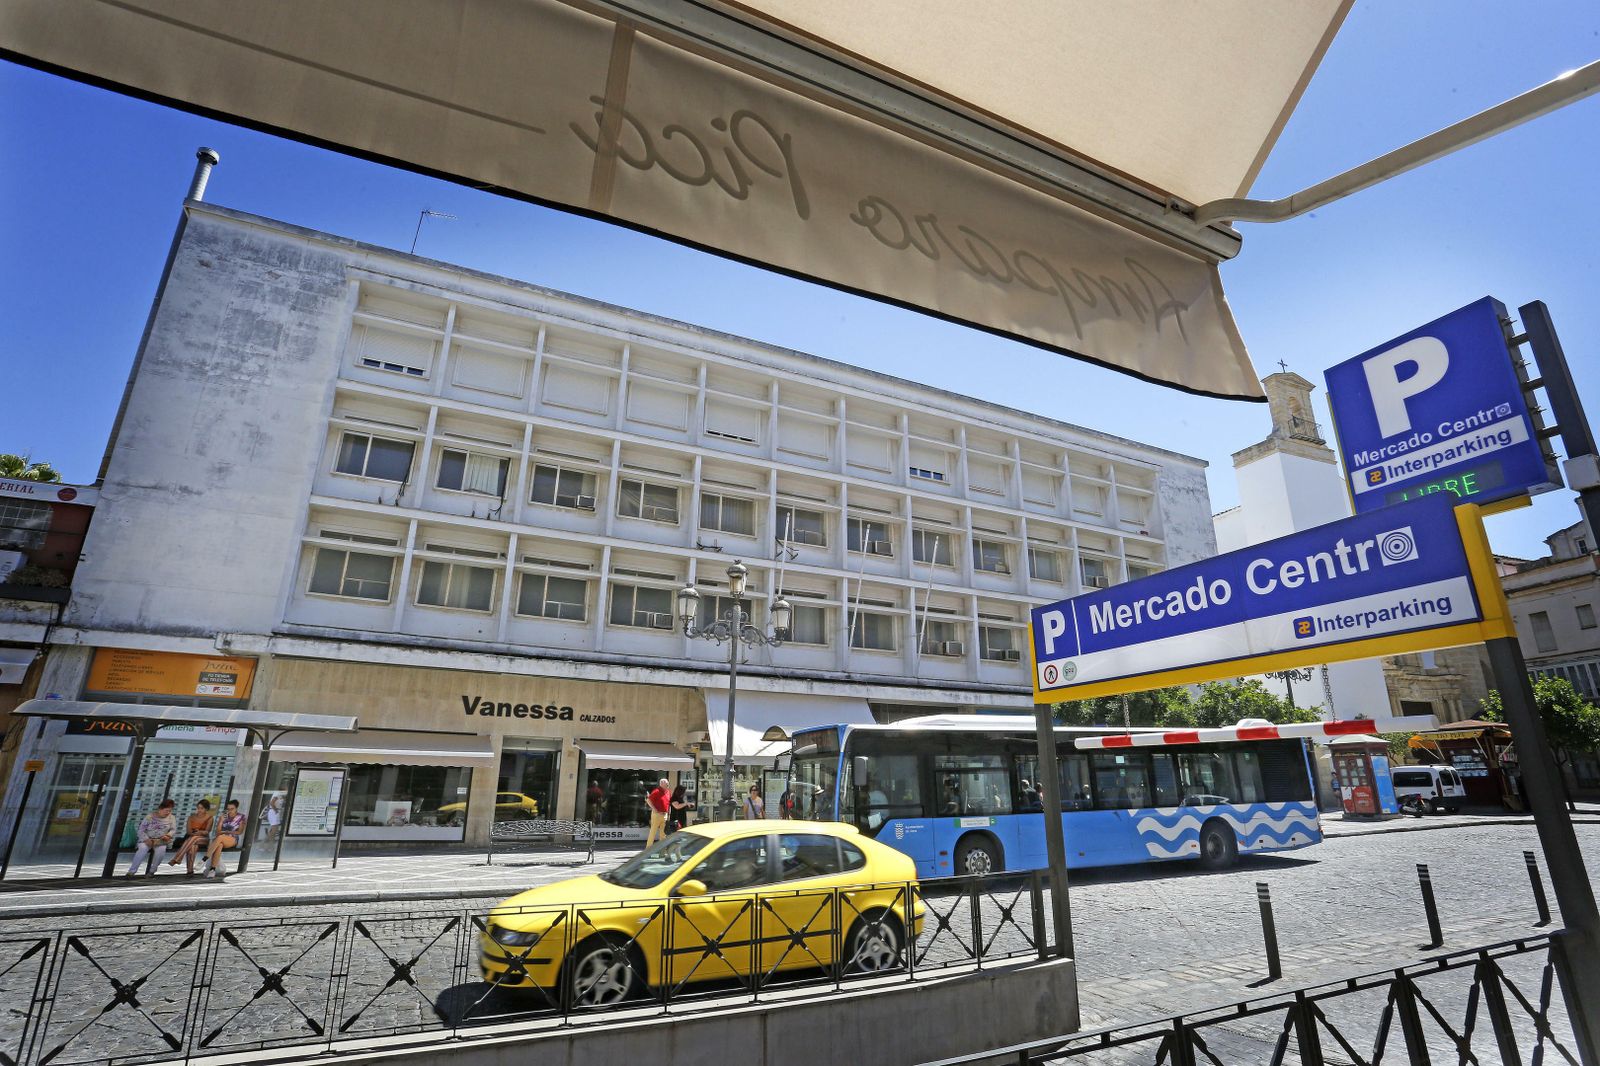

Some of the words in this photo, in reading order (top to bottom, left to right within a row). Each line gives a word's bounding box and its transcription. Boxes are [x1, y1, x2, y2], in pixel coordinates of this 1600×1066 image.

[1362, 336, 1450, 440] P
[1353, 429, 1433, 467] Mercado
[1387, 429, 1513, 479] Interparking
[1403, 473, 1480, 501] BRE
[1089, 576, 1232, 635] Mercado
[1317, 593, 1453, 634] Interparking
[1041, 610, 1066, 655] P
[462, 696, 574, 721] Vanessa
[580, 714, 616, 723] CALZADOS
[580, 831, 623, 839] nessa
